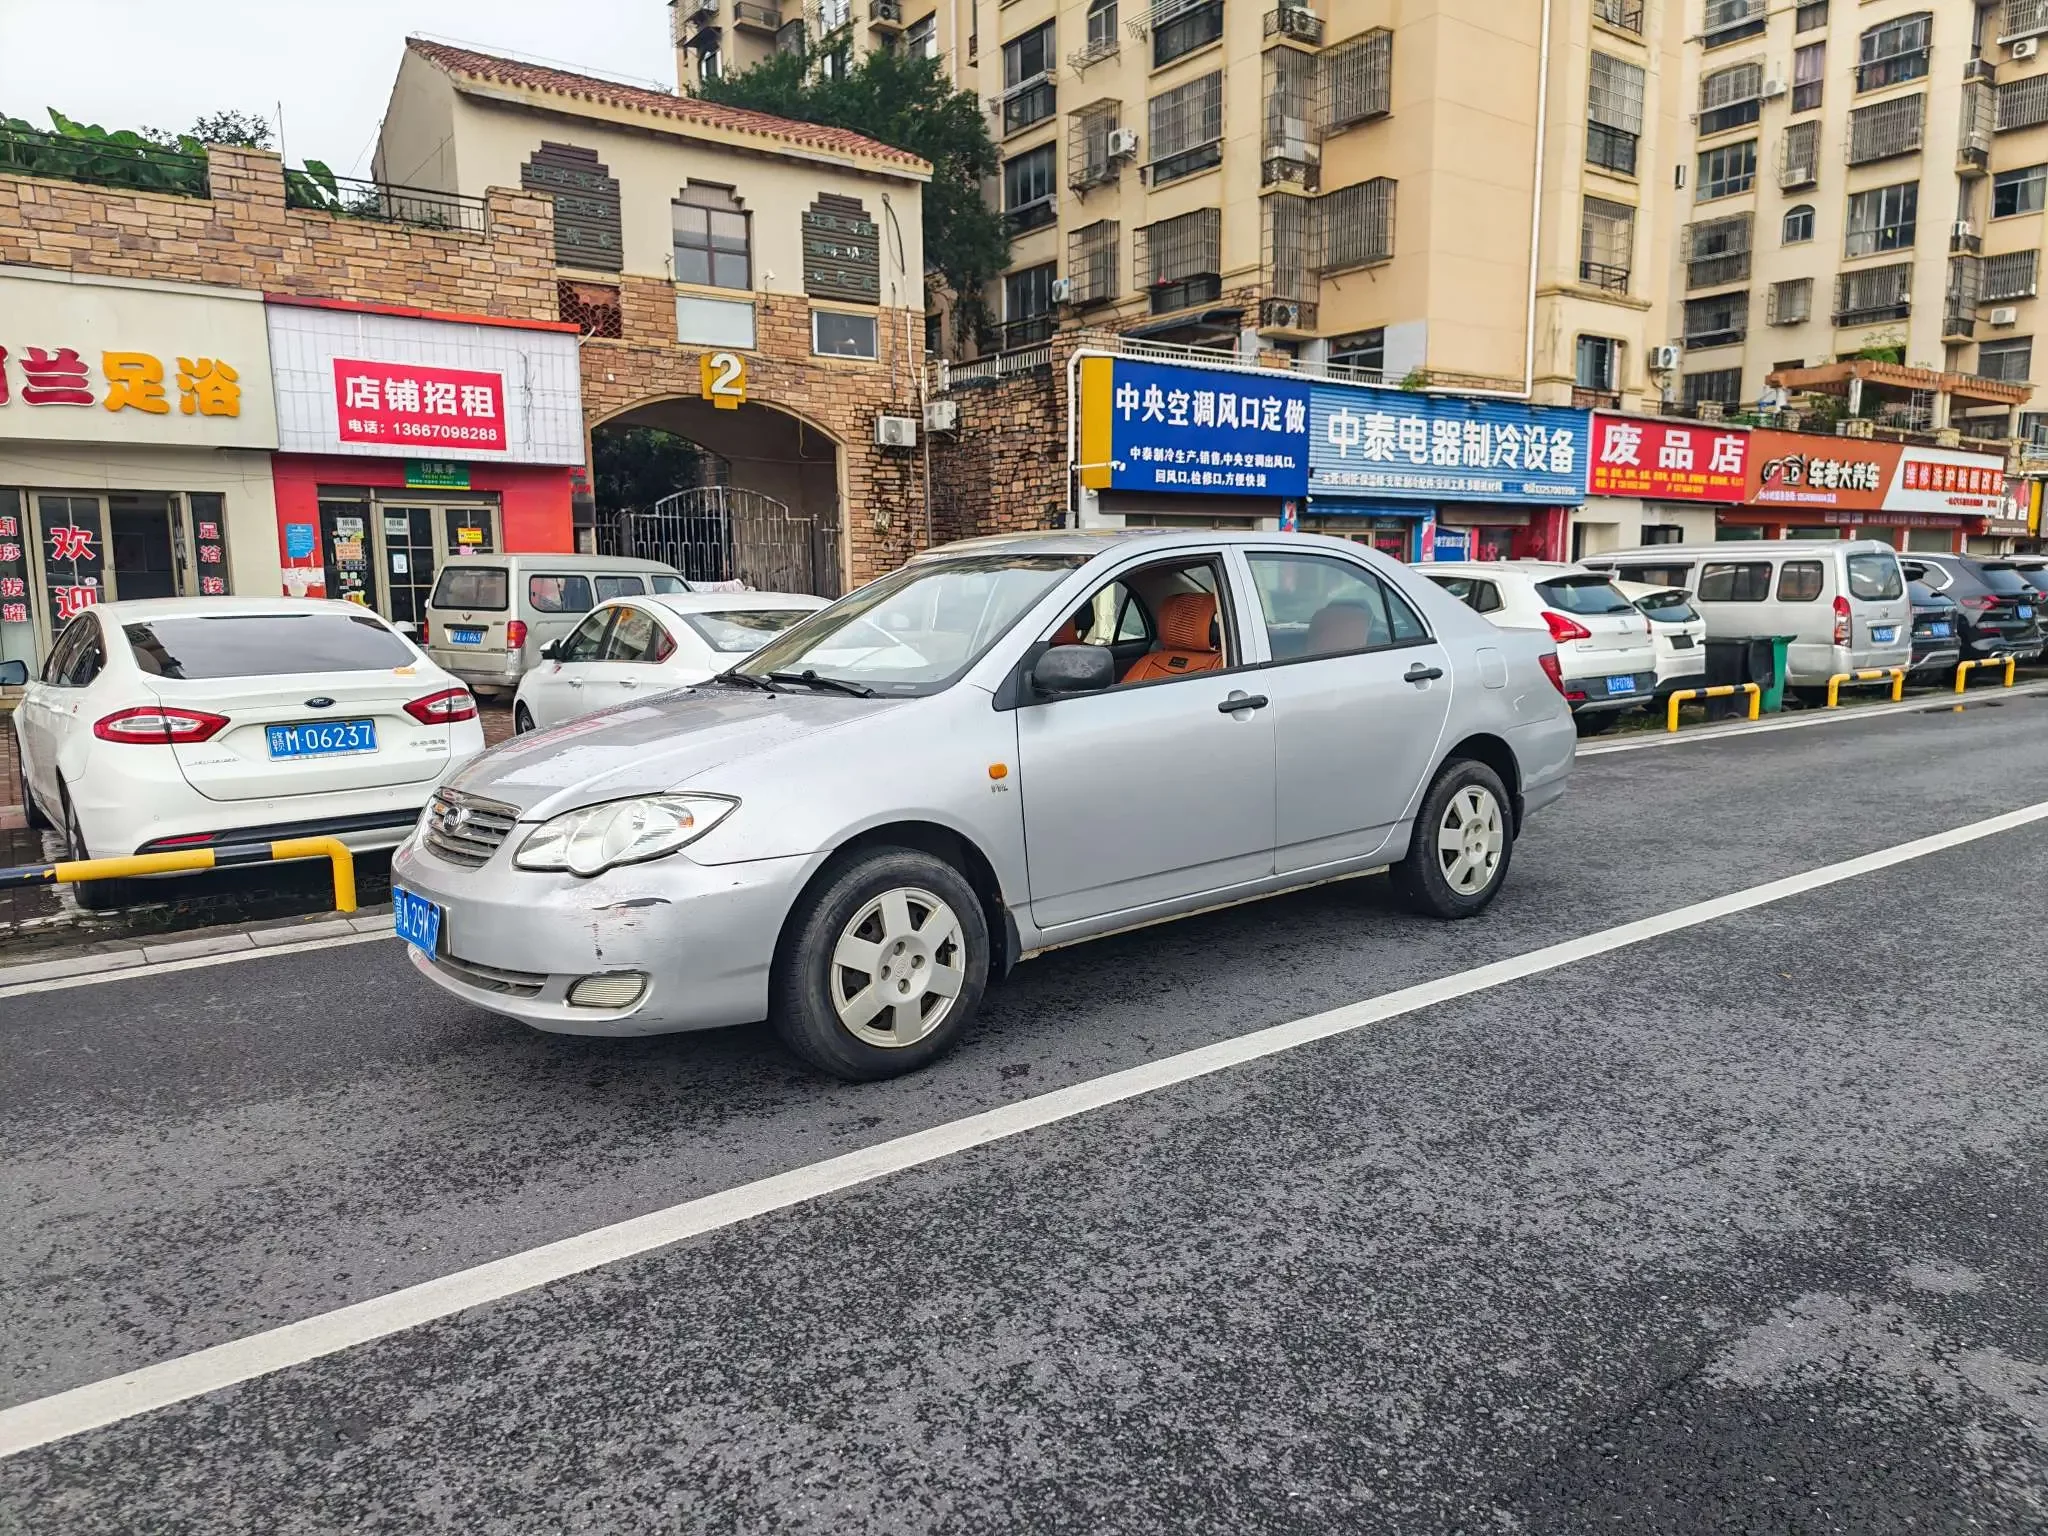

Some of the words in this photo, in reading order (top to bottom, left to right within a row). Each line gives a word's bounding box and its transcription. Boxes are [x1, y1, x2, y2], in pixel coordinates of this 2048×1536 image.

[0, 344, 241, 418] 兰足浴
[345, 375, 496, 418] 店铺招租
[709, 352, 743, 396] 2
[1115, 382, 1306, 434] 中央空调风口定做
[1327, 407, 1575, 474] 中泰电器制冷设备
[1599, 423, 1745, 474] 废品店
[1808, 457, 1881, 490] 车老大养车
[50, 525, 97, 621] 欢迎
